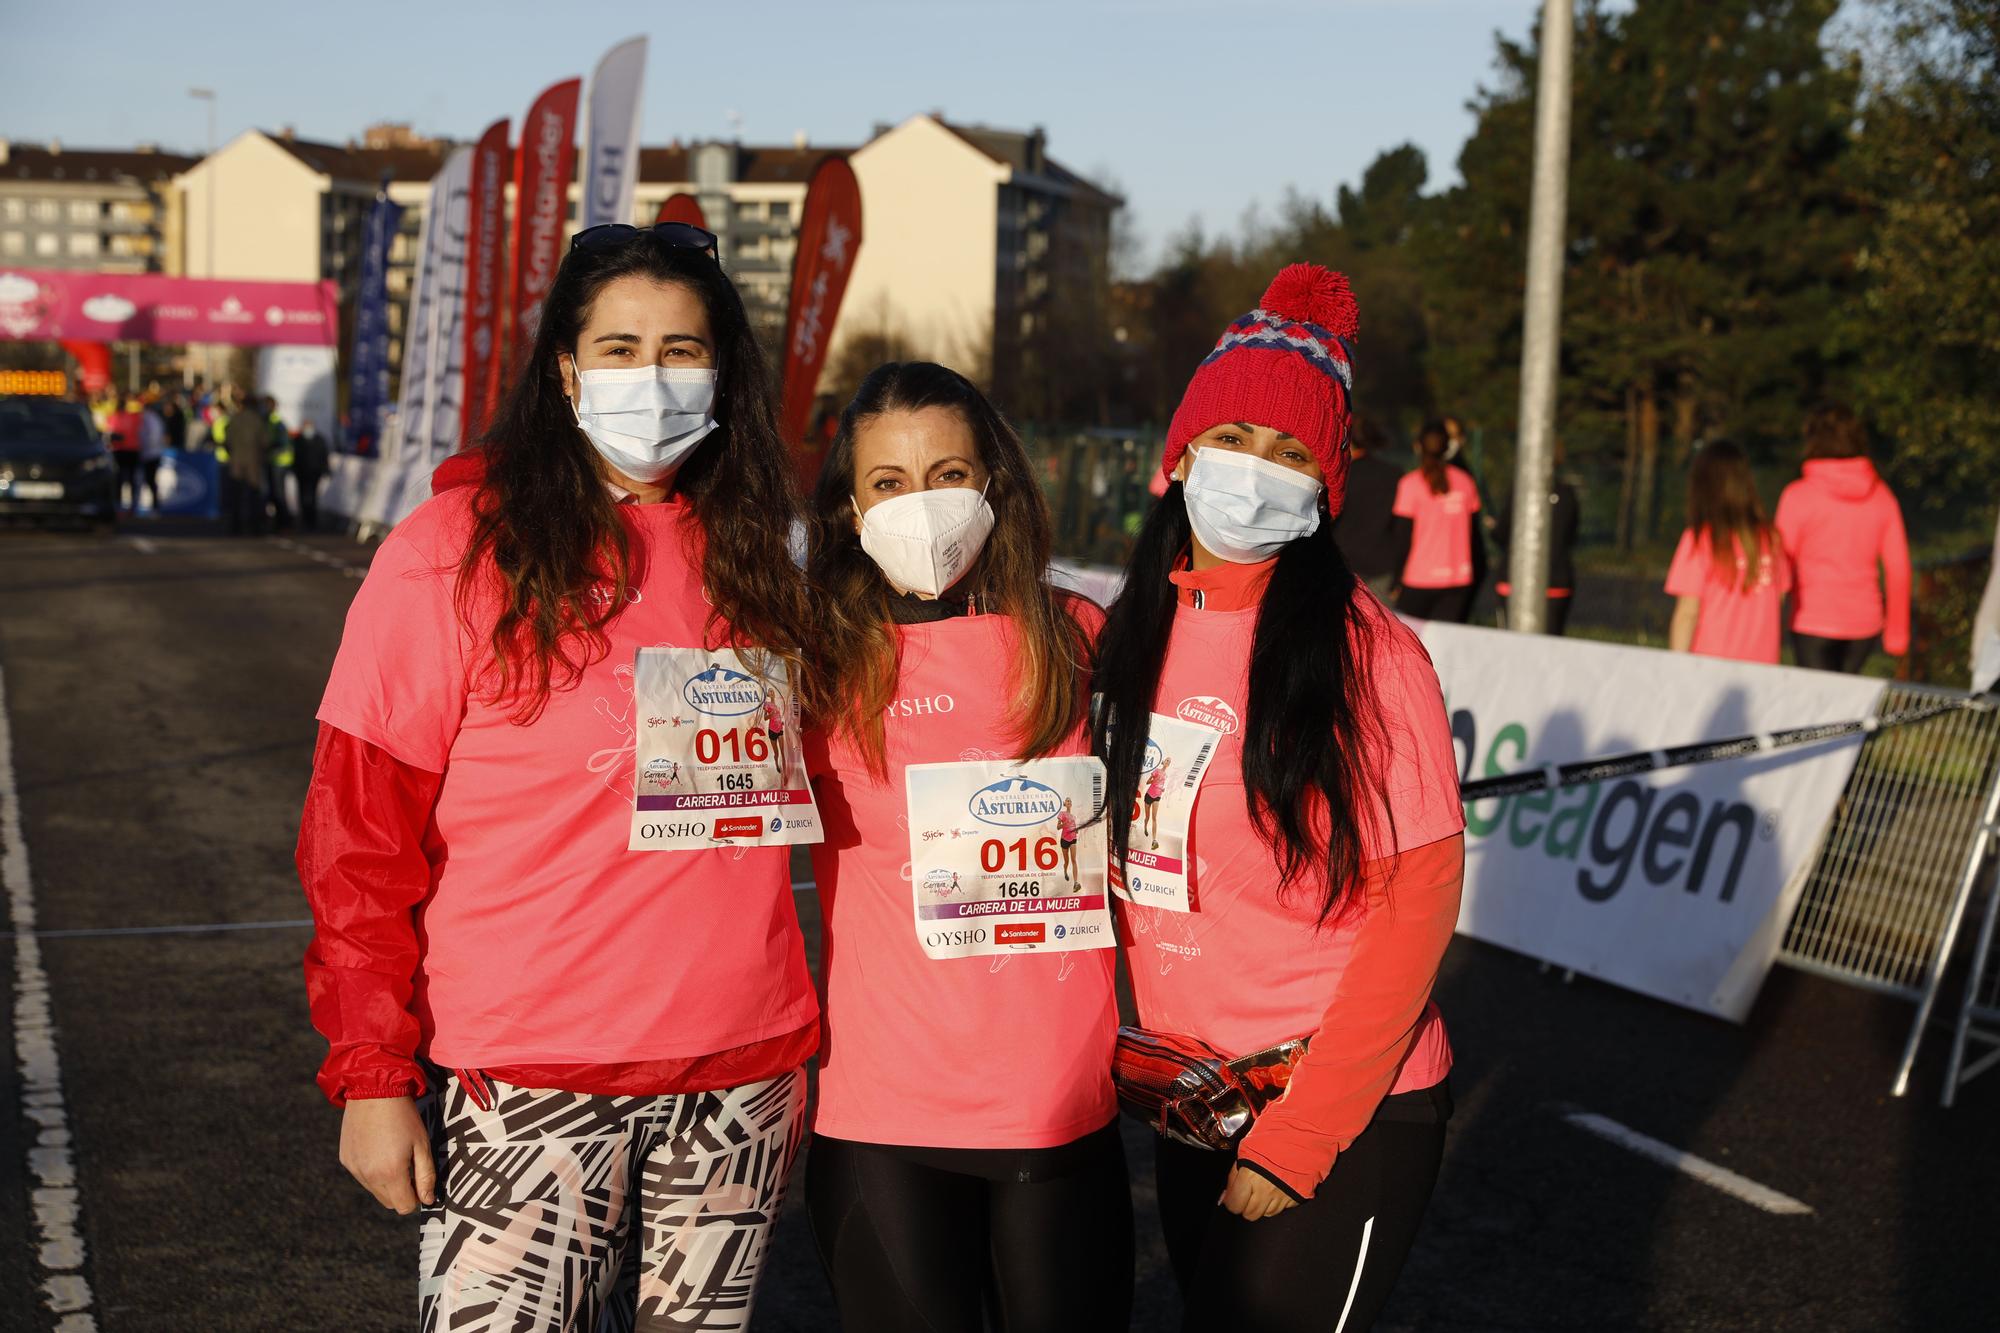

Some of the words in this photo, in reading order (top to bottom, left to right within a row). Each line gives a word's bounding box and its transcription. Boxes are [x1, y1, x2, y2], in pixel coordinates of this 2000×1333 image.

[525, 108, 564, 294] Santander
[1180, 702, 1232, 732] ASTURIANA
[695, 727, 769, 764] 016
[716, 773, 754, 791] 1645
[676, 796, 726, 808] CARRERA
[730, 794, 742, 806] DE
[745, 793, 758, 804] LA
[977, 798, 1056, 816] ASTURIANA
[1466, 721, 1757, 903] Seagen
[640, 822, 706, 838] OYSHO
[786, 820, 812, 828] ZURICH
[980, 836, 1058, 873] 016
[1128, 850, 1158, 867] MUJER
[999, 881, 1040, 898] 1646
[1144, 882, 1175, 896] ZURICH
[959, 902, 1006, 916] CARRERA
[1010, 900, 1026, 912] DE
[1028, 900, 1043, 911] LA
[1046, 898, 1081, 910] MUJER
[926, 928, 986, 947] OYSHO
[1070, 925, 1100, 935] ZURICH
[1179, 946, 1200, 956] 2021
